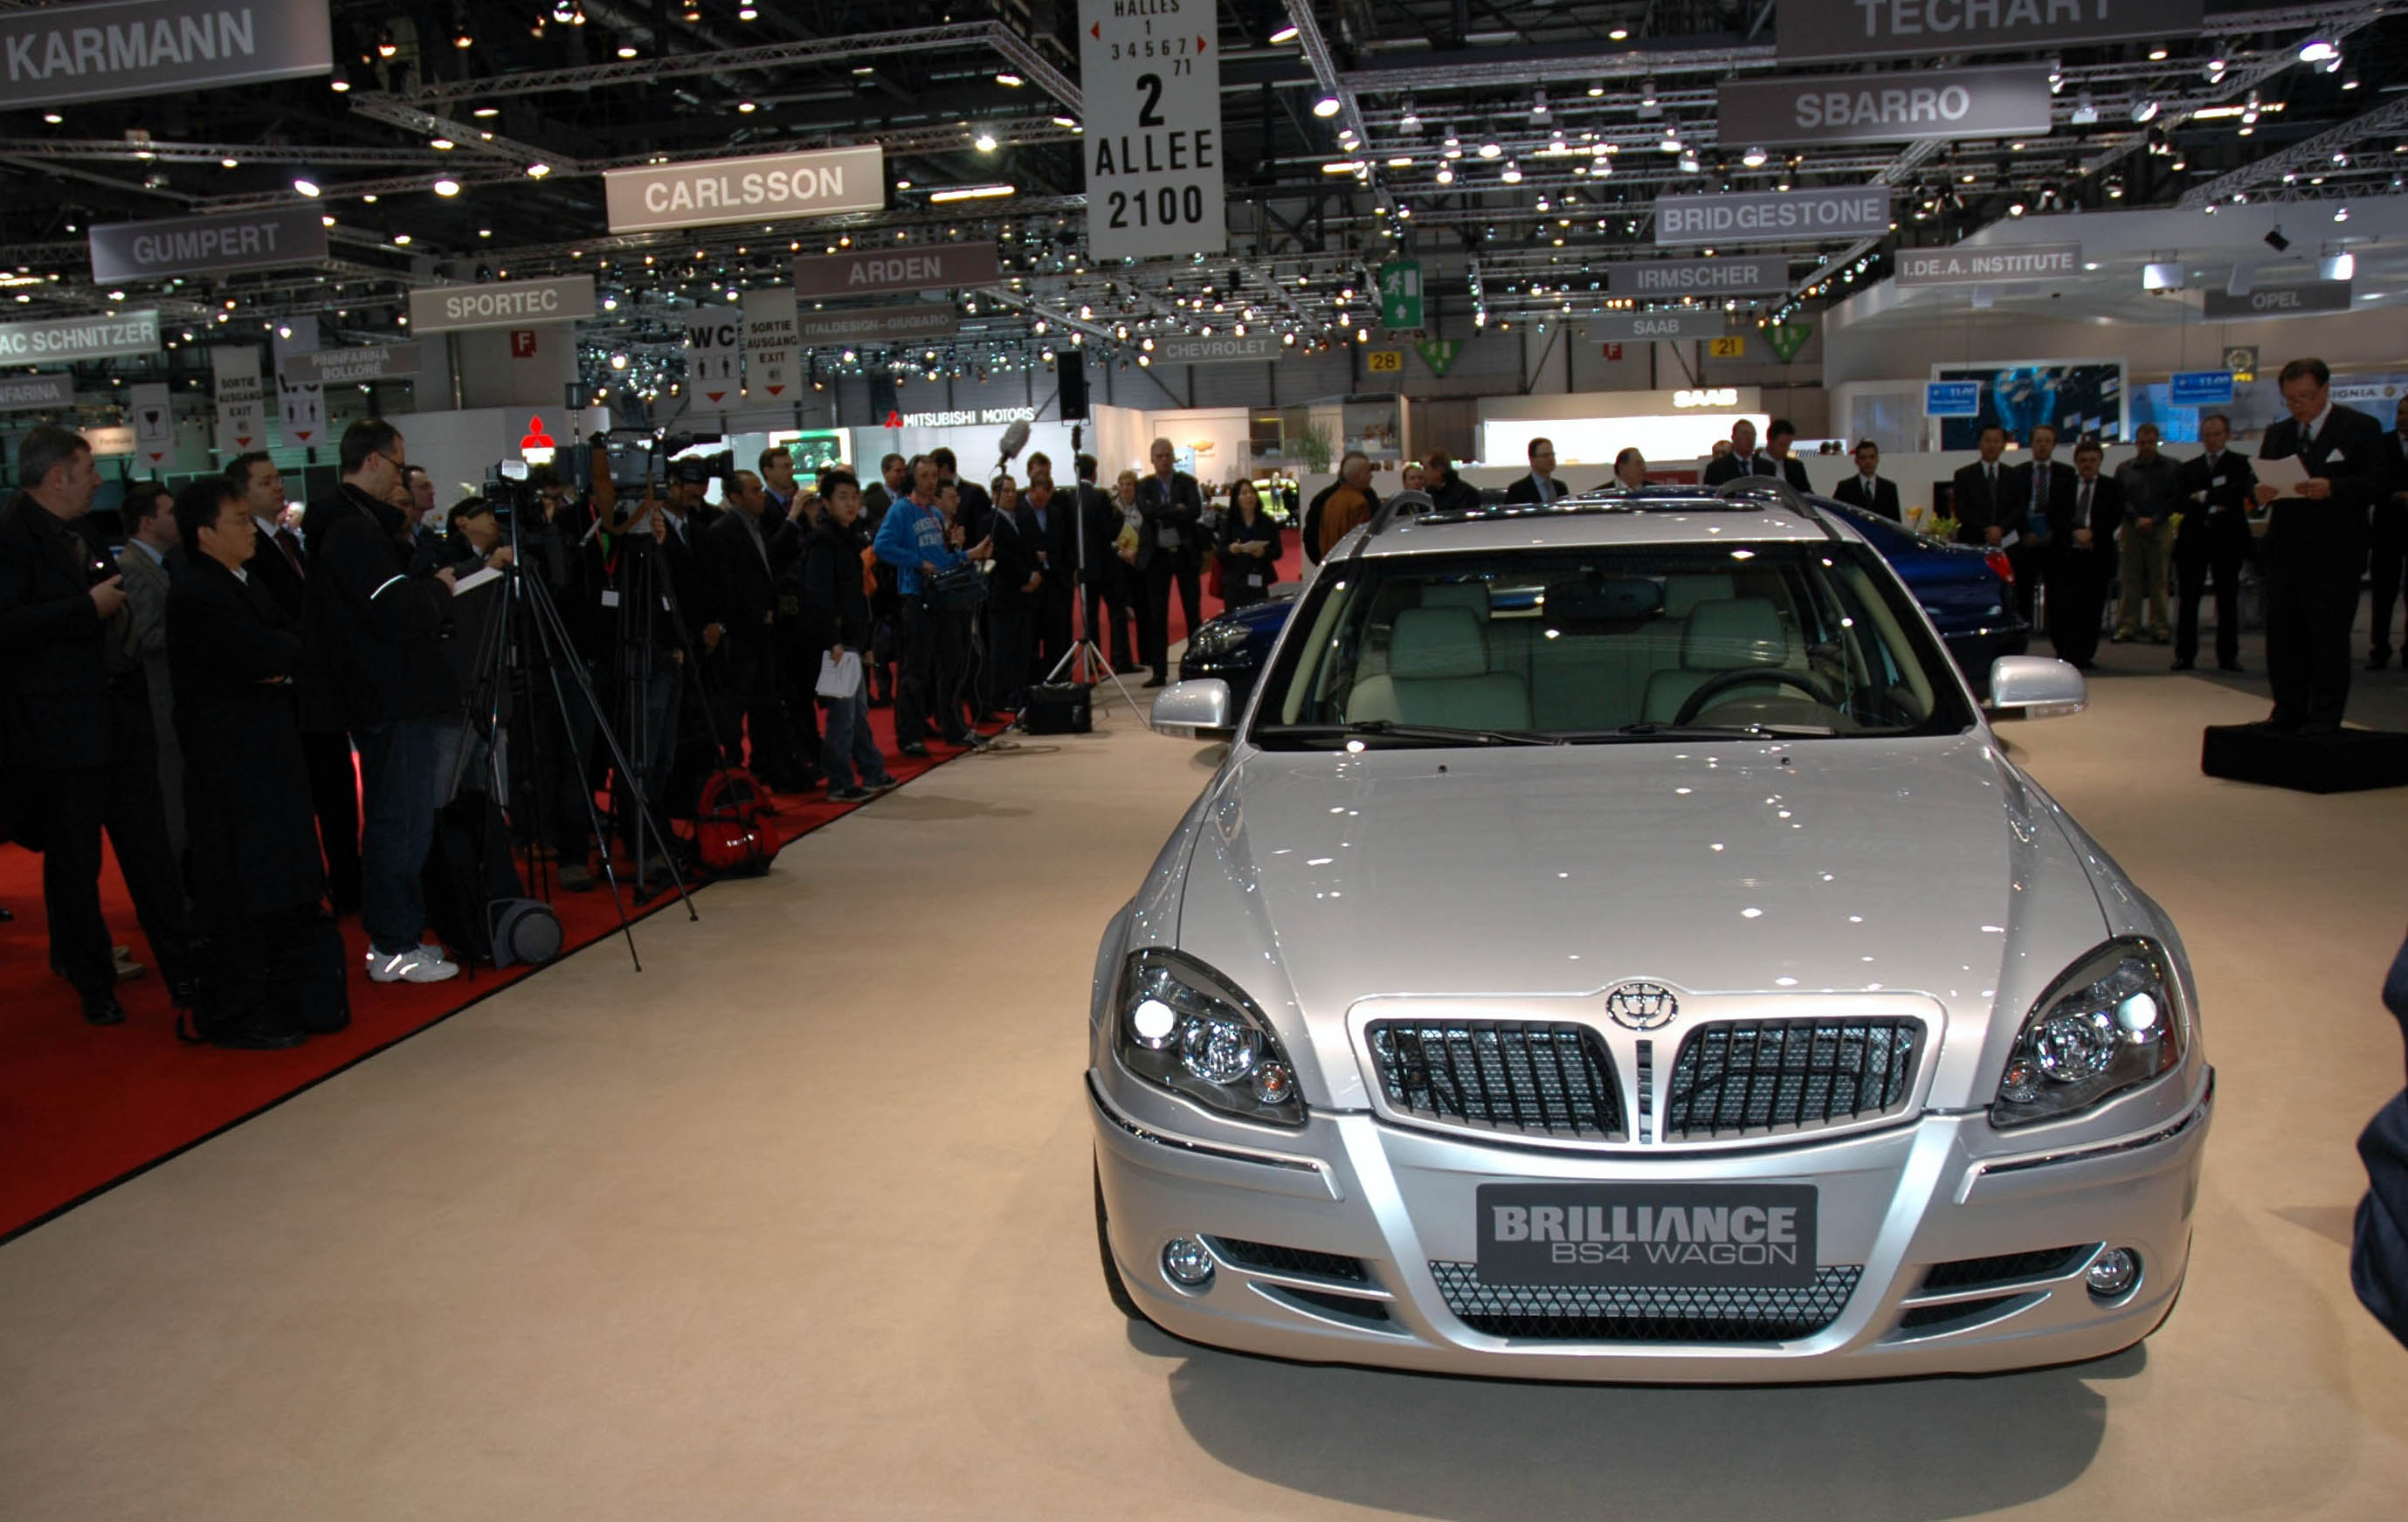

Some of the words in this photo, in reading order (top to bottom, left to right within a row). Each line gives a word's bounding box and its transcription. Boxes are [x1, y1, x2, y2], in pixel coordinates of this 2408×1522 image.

[1115, 0, 1179, 17] HALLES
[1146, 19, 1151, 35] 1
[5, 8, 255, 82] KARMANN
[1112, 44, 1120, 59] 3
[1128, 42, 1136, 58] 4
[1146, 41, 1154, 57] 5
[1162, 40, 1170, 56] 6
[1179, 38, 1186, 54] 7
[1174, 59, 1191, 76] 71
[1136, 73, 1165, 127] 2
[1796, 86, 1970, 128] SBARRO
[1095, 129, 1213, 176] ALLEE
[645, 166, 844, 212] CARLSSON
[1108, 184, 1203, 229] 2100
[1664, 198, 1881, 232] BRIDGESTONE
[134, 223, 279, 264] GUMPERT
[848, 256, 942, 286] ARDEN
[1972, 252, 2073, 273] INSTITUTE
[1638, 265, 1759, 289] IRMSCHER
[446, 288, 557, 319] SPORTEC
[2252, 290, 2301, 309] OPEL
[690, 324, 735, 348] WC
[751, 320, 791, 334] SORTIE
[1633, 319, 1680, 335] SAAB
[0, 334, 27, 355] AC
[33, 321, 155, 350] SCHNITZER
[518, 332, 529, 350] F
[747, 335, 797, 349] AUSGANG
[1718, 340, 1736, 355] 21
[759, 352, 786, 363] EXIT
[1167, 339, 1266, 359] CHEVROLET
[1373, 354, 1396, 369] 28
[1673, 389, 1737, 408] SAAB
[230, 406, 252, 417] EXIT
[903, 411, 976, 426] MITSUBISHI
[982, 407, 1035, 423] MOTORS
[1492, 1206, 1797, 1243] BRILLIANCE
[1552, 1243, 1631, 1264] BS4
[1644, 1243, 1796, 1265] WAGON
